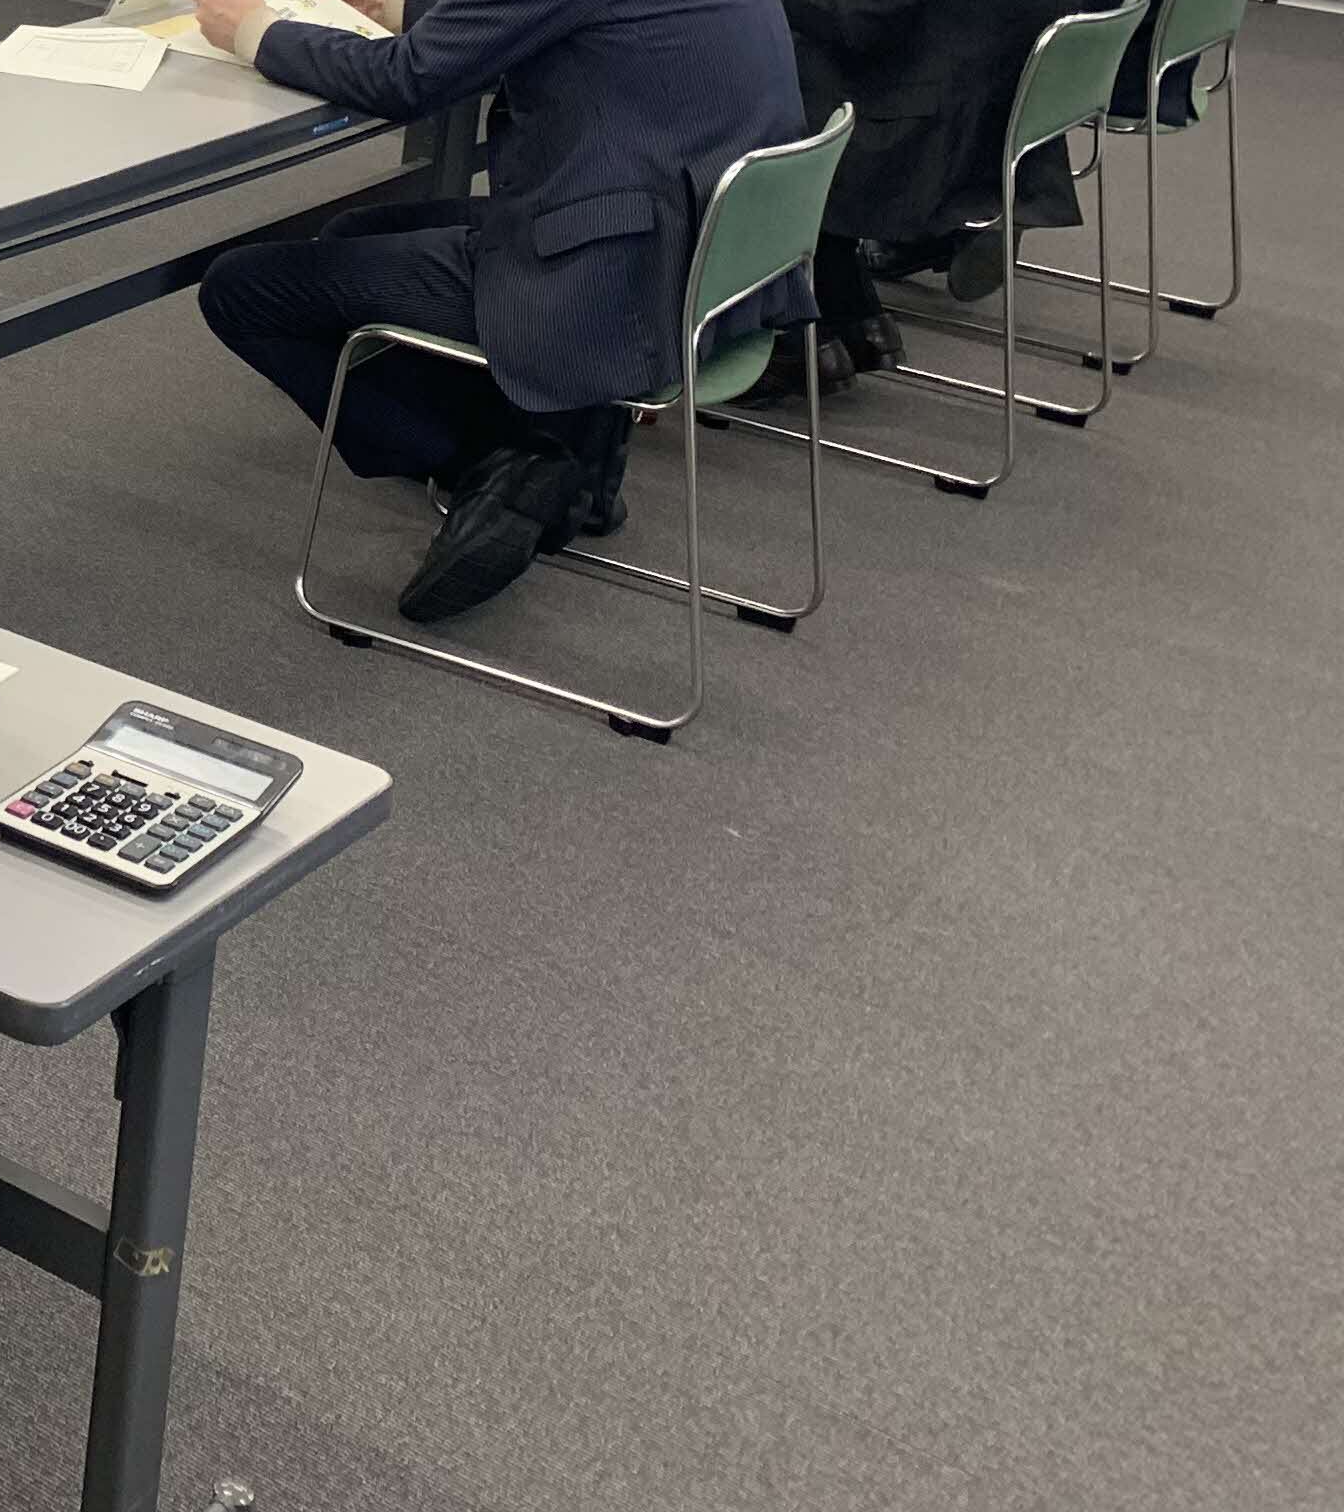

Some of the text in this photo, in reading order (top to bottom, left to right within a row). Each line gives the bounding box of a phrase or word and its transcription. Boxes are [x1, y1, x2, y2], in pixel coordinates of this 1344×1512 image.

[86, 784, 100, 792] 7
[72, 794, 85, 803] 4
[112, 793, 125, 802] 8
[60, 804, 70, 812] 1
[98, 804, 112, 812] 5
[138, 803, 151, 812] 9
[41, 813, 54, 821] 0
[83, 814, 97, 822] 2
[124, 814, 137, 823] 6
[65, 823, 85, 834] 00
[109, 823, 122, 832] 3
